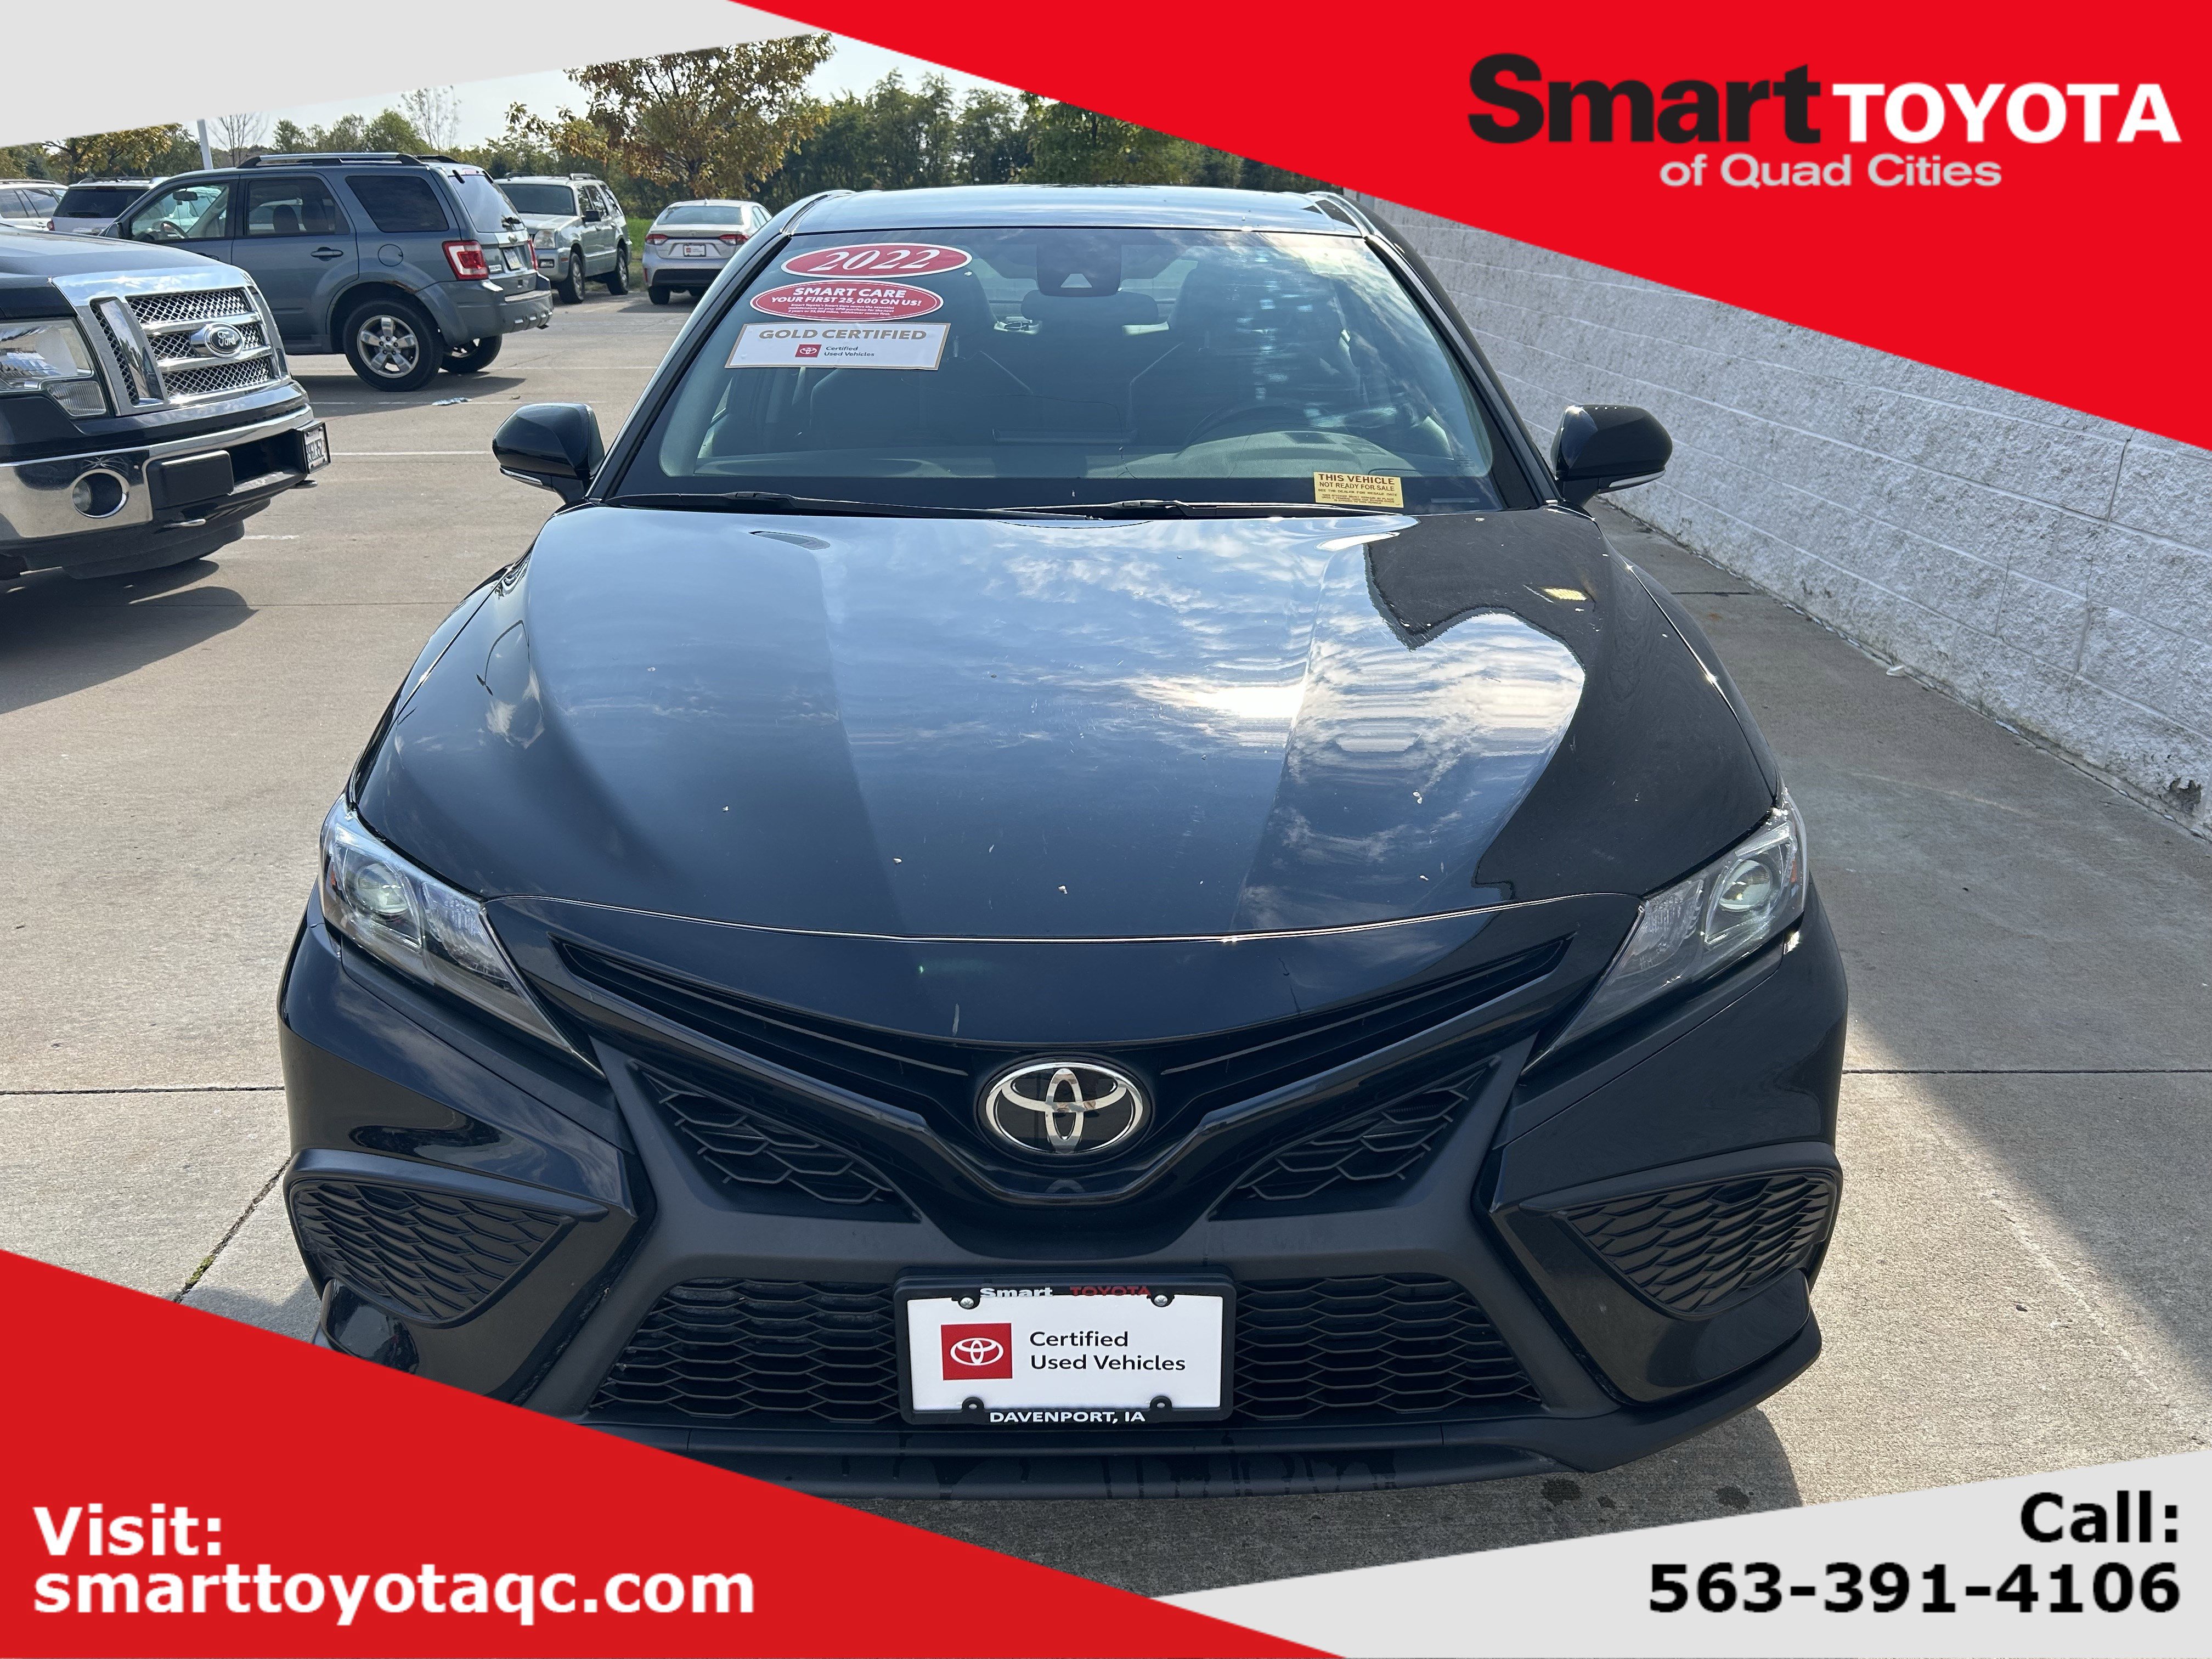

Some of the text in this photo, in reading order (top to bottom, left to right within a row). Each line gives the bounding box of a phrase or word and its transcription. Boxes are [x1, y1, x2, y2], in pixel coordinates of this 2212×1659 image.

[808, 249, 940, 272] 2022
[793, 287, 906, 298] SMART CARE
[217, 331, 236, 347] Ford
[759, 329, 927, 340] GOLD CERTIFIED
[1347, 475, 1395, 485] VEHICLE
[980, 1286, 1152, 1297] Smart TOYOTA
[1029, 1330, 1129, 1347] Certified
[1031, 1354, 1186, 1371] Used Vehicles
[990, 1412, 1146, 1424] DAVENPORT, IA
